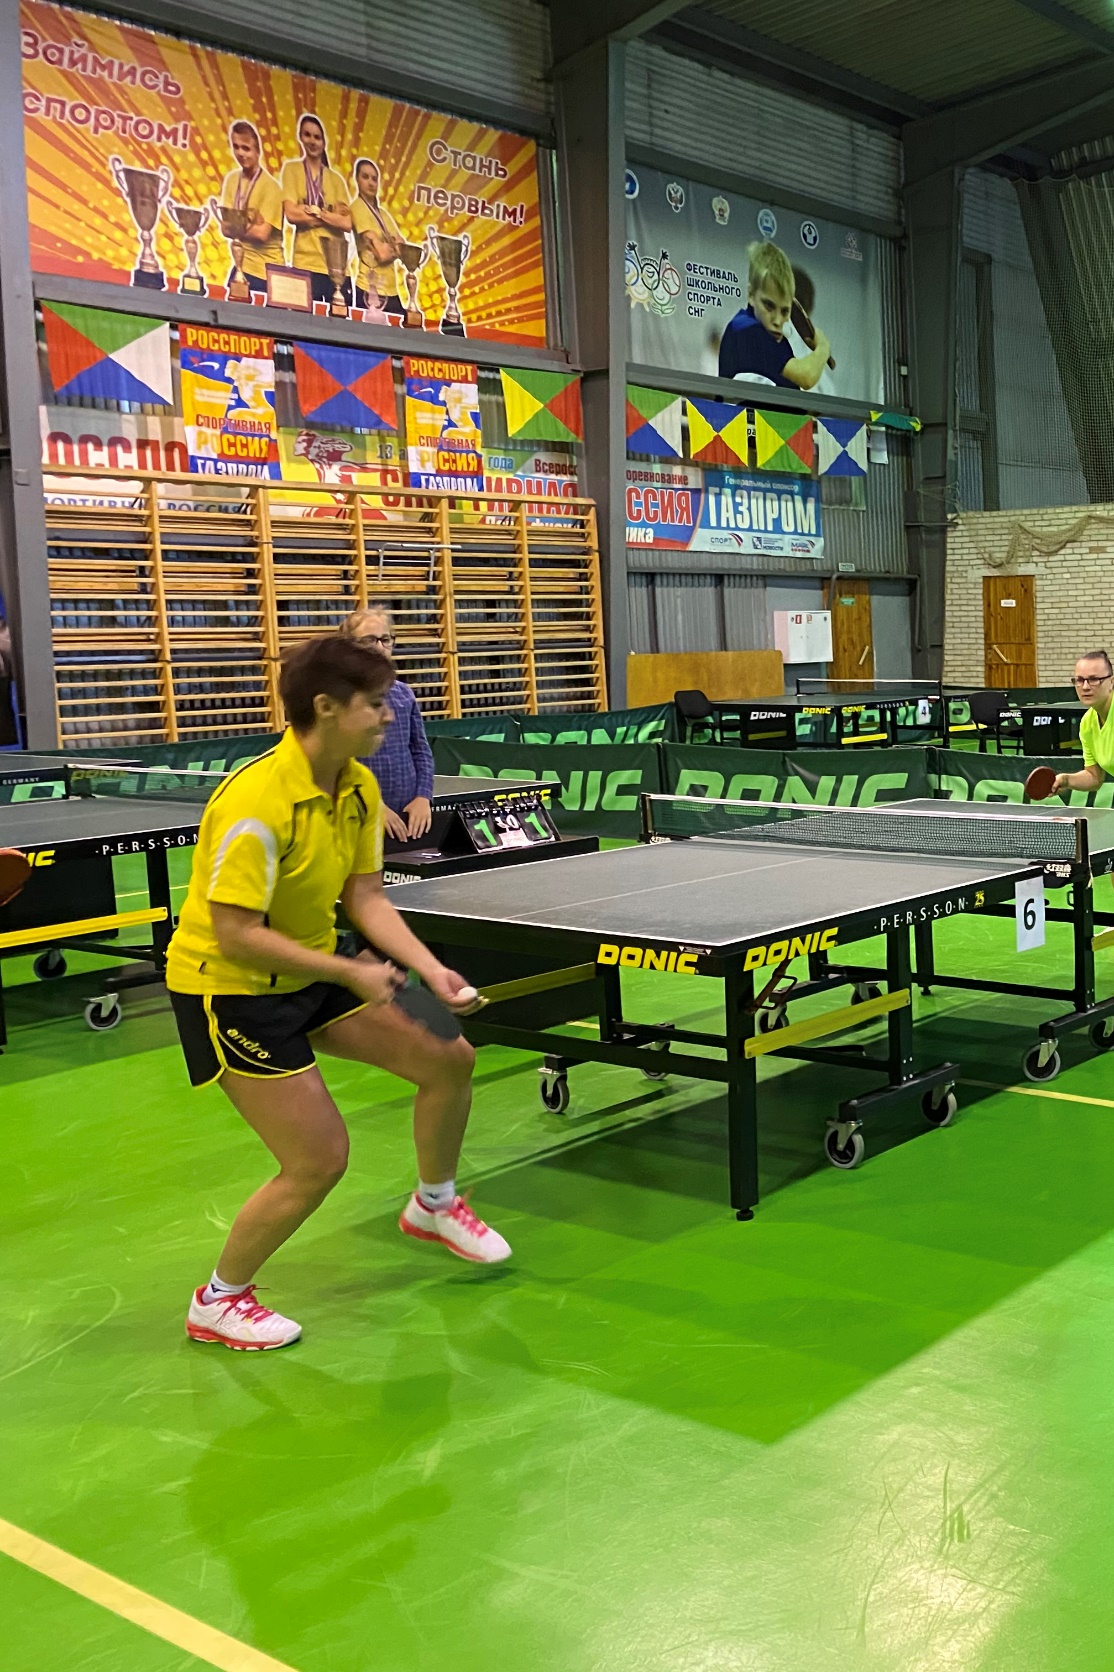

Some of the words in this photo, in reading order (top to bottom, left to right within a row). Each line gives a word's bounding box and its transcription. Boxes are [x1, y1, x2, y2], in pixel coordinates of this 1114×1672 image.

[21, 29, 183, 99] Займись
[22, 89, 191, 150] спортом!
[427, 137, 508, 181] Стань
[414, 181, 526, 227] первым!
[685, 261, 739, 284] ФЕСТИВАЛЬ
[686, 276, 742, 299] ШКОЛЬНОГО
[687, 291, 723, 308] СПОРТА
[687, 305, 705, 318] СНГ
[186, 327, 270, 358] РОССПОРТ
[195, 413, 272, 435] СПОРТИВНАЯ
[196, 432, 270, 459] РОССИЯ
[376, 443, 393, 459] 13
[487, 456, 514, 470] года
[534, 458, 578, 476] Всеросс
[625, 468, 689, 486] оревнование
[625, 485, 693, 526] ССИЯ
[708, 486, 817, 535] ГАЗПРОМ
[750, 711, 787, 720] DONIC
[802, 707, 832, 715] DONIC
[841, 705, 866, 714] DONIC
[458, 764, 643, 811] NIC
[473, 819, 498, 846] 1
[524, 812, 549, 838] 1
[383, 870, 422, 885] DONIC
[1022, 898, 1037, 931] 6
[597, 943, 701, 975] DONIC
[743, 926, 839, 971] DONIC
[226, 1028, 270, 1060] andro
